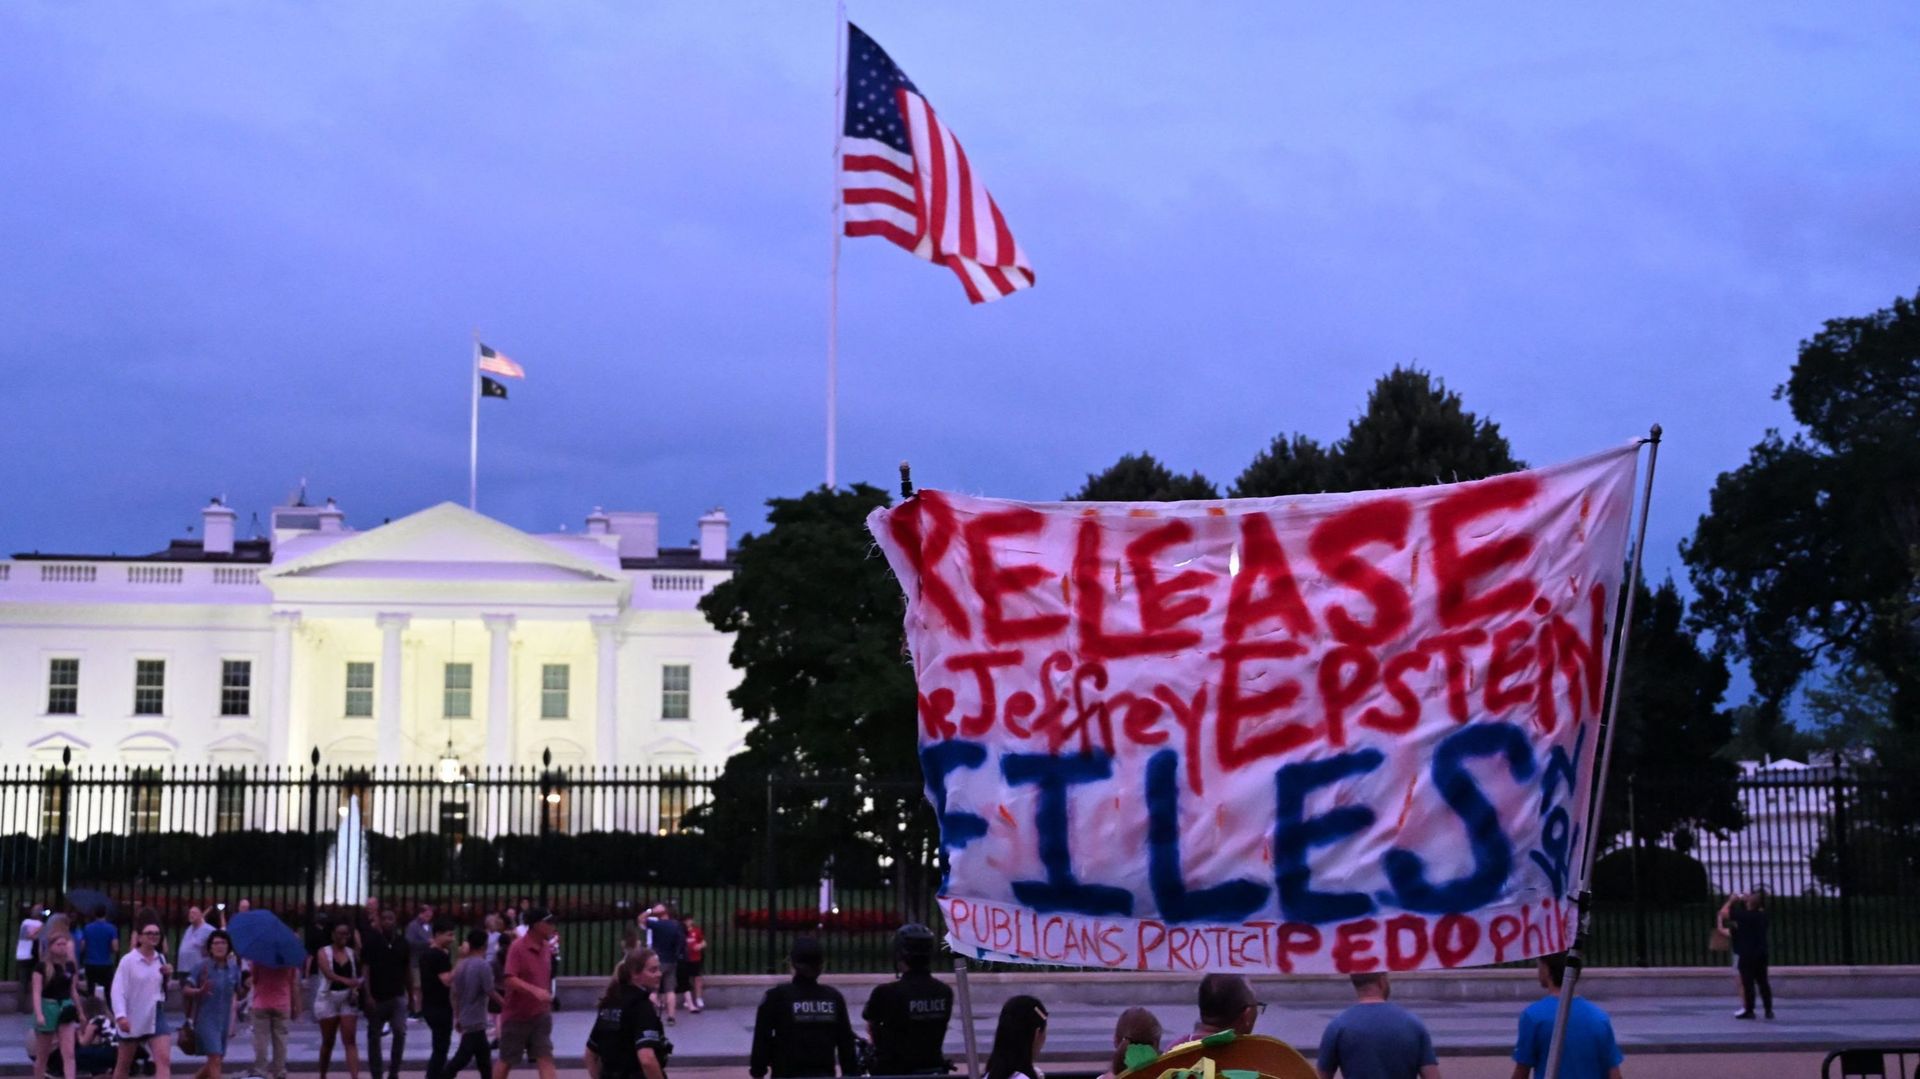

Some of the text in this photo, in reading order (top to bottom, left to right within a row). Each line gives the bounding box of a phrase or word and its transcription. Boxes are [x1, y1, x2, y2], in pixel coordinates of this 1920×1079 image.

[891, 474, 1541, 660] RELEASE
[921, 722, 1537, 924] FILES
[1136, 919, 1277, 971] PROTECT
[793, 1001, 834, 1014] POLICE
[910, 999, 945, 1013] POLICE
